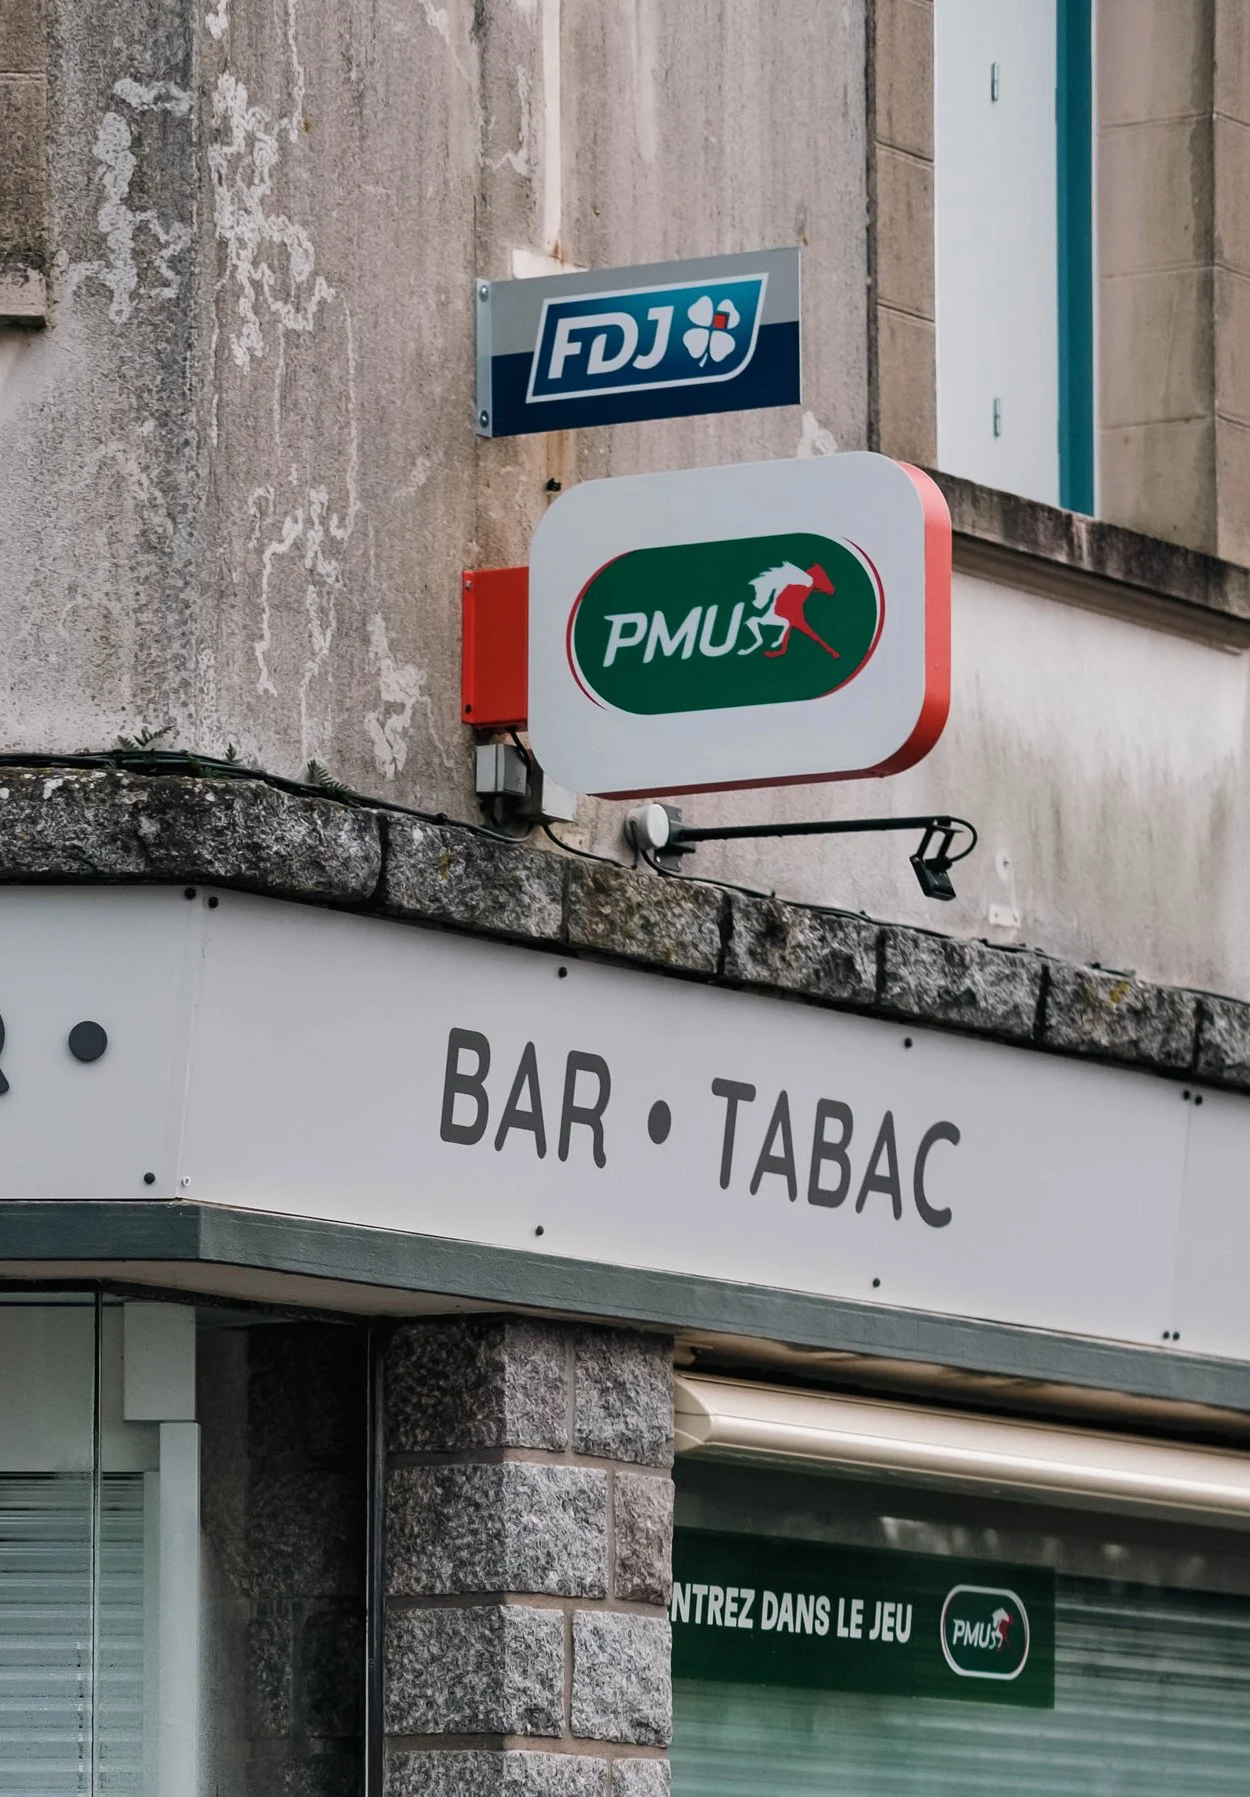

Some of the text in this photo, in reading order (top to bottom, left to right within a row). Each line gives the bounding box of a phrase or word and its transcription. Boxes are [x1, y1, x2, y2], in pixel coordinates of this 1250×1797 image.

[547, 304, 674, 380] FDJ
[602, 602, 747, 668] PMU
[439, 1026, 962, 1229] BAR TABAC
[667, 1581, 913, 1644] NTREZ DANS LE JEU
[951, 1618, 991, 1649] PMU
